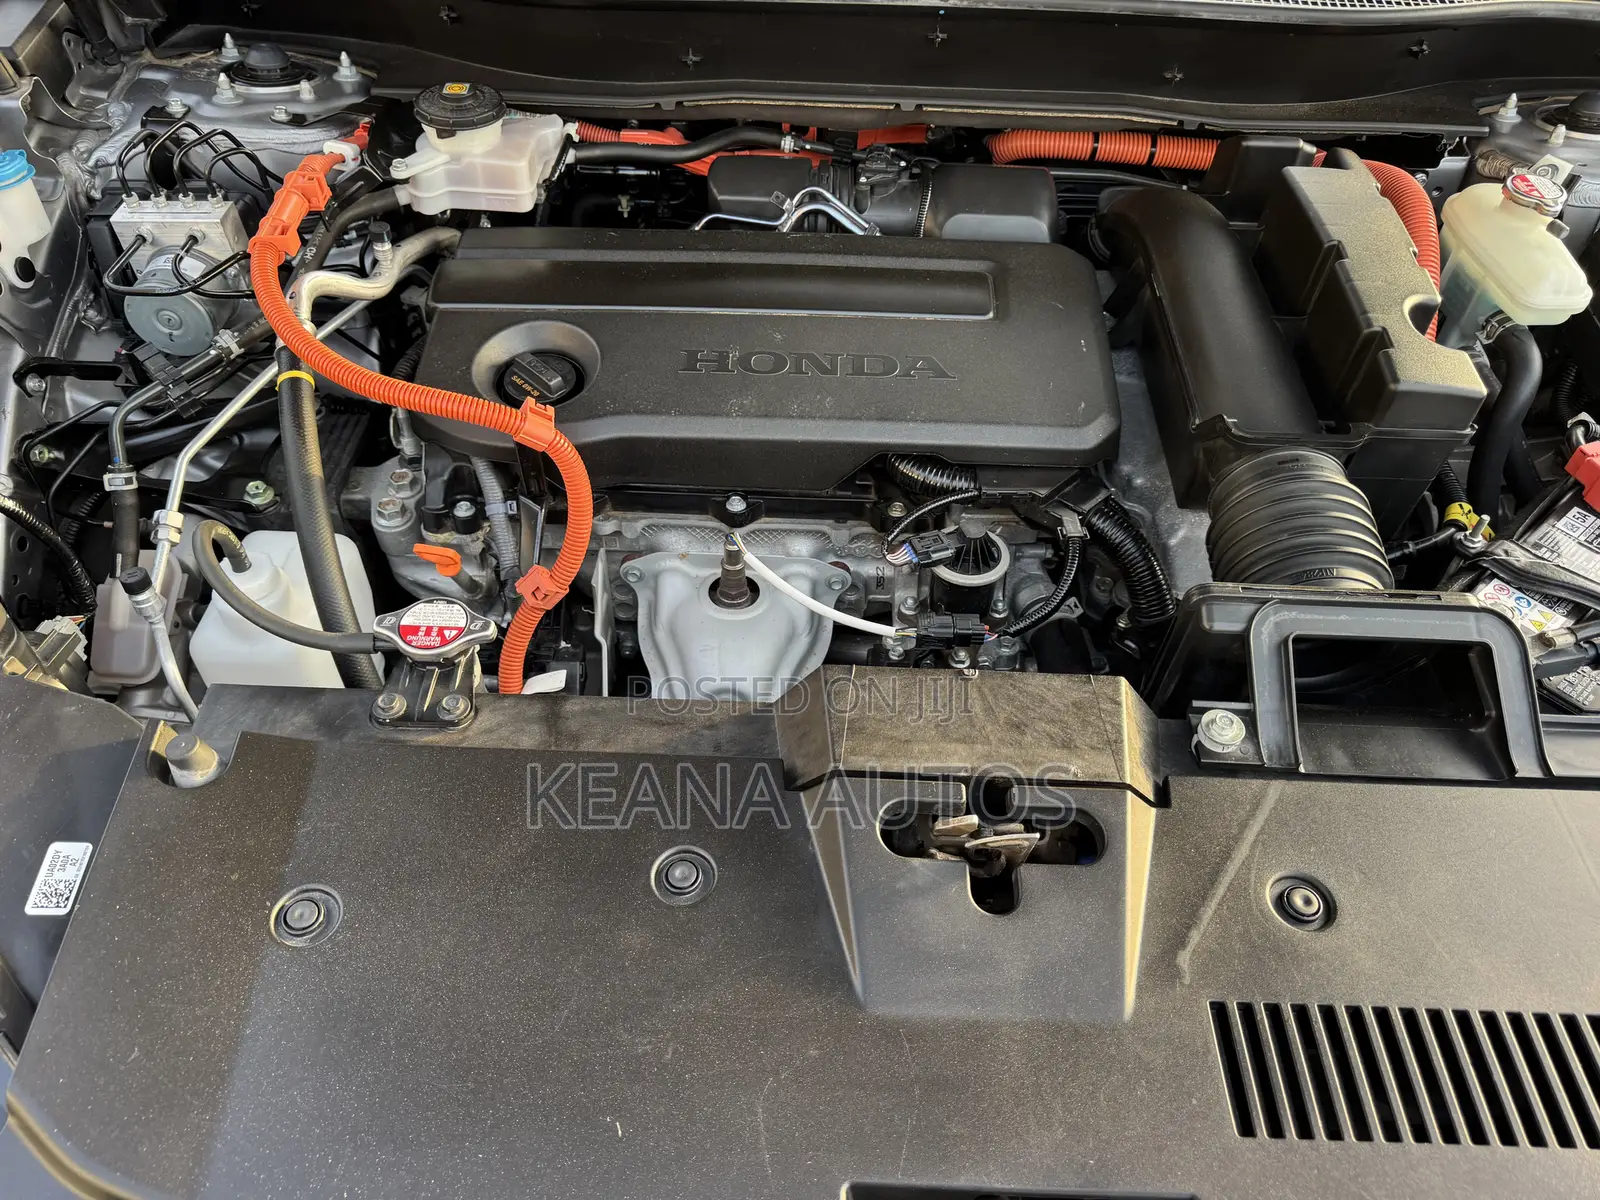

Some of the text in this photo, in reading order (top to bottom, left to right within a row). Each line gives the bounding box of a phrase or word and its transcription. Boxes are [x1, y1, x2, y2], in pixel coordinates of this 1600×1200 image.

[678, 349, 958, 380] HONDA
[511, 375, 540, 397] SAE 0W-20
[69, 857, 80, 867] A2
